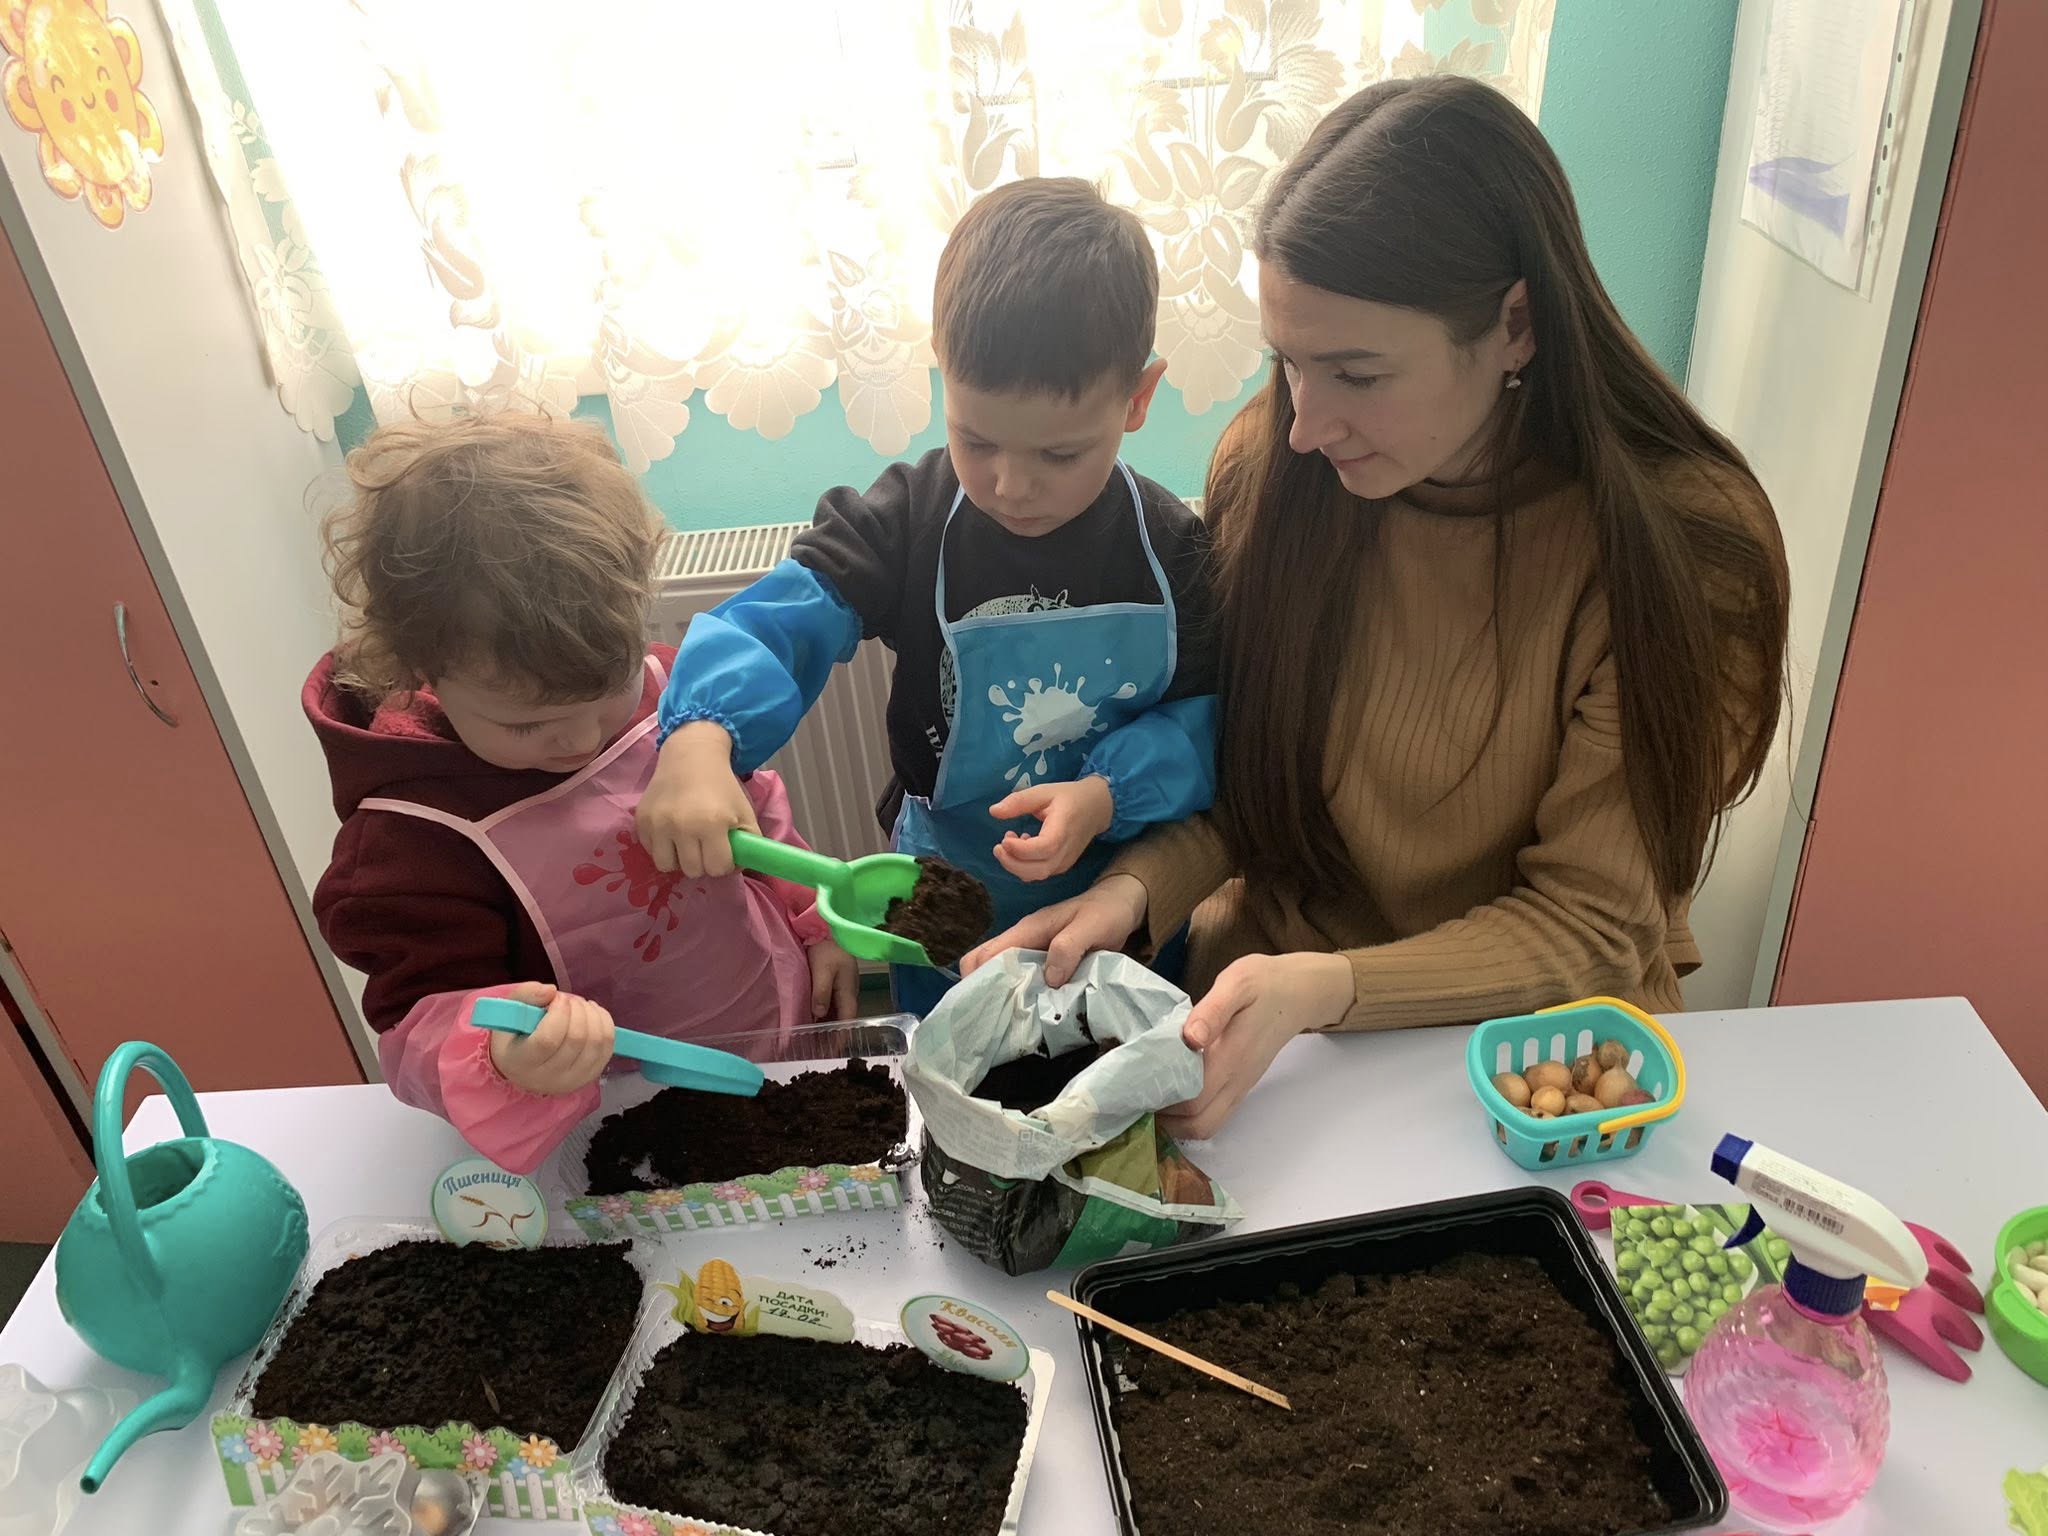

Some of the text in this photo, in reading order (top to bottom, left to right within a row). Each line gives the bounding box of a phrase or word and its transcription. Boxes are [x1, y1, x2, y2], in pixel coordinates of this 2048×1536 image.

[442, 1172, 522, 1196] Пшениця
[759, 1295, 830, 1319] ПОСАДКИ:
[776, 1291, 814, 1306] ДАТА
[940, 1300, 1018, 1348] Квасоля
